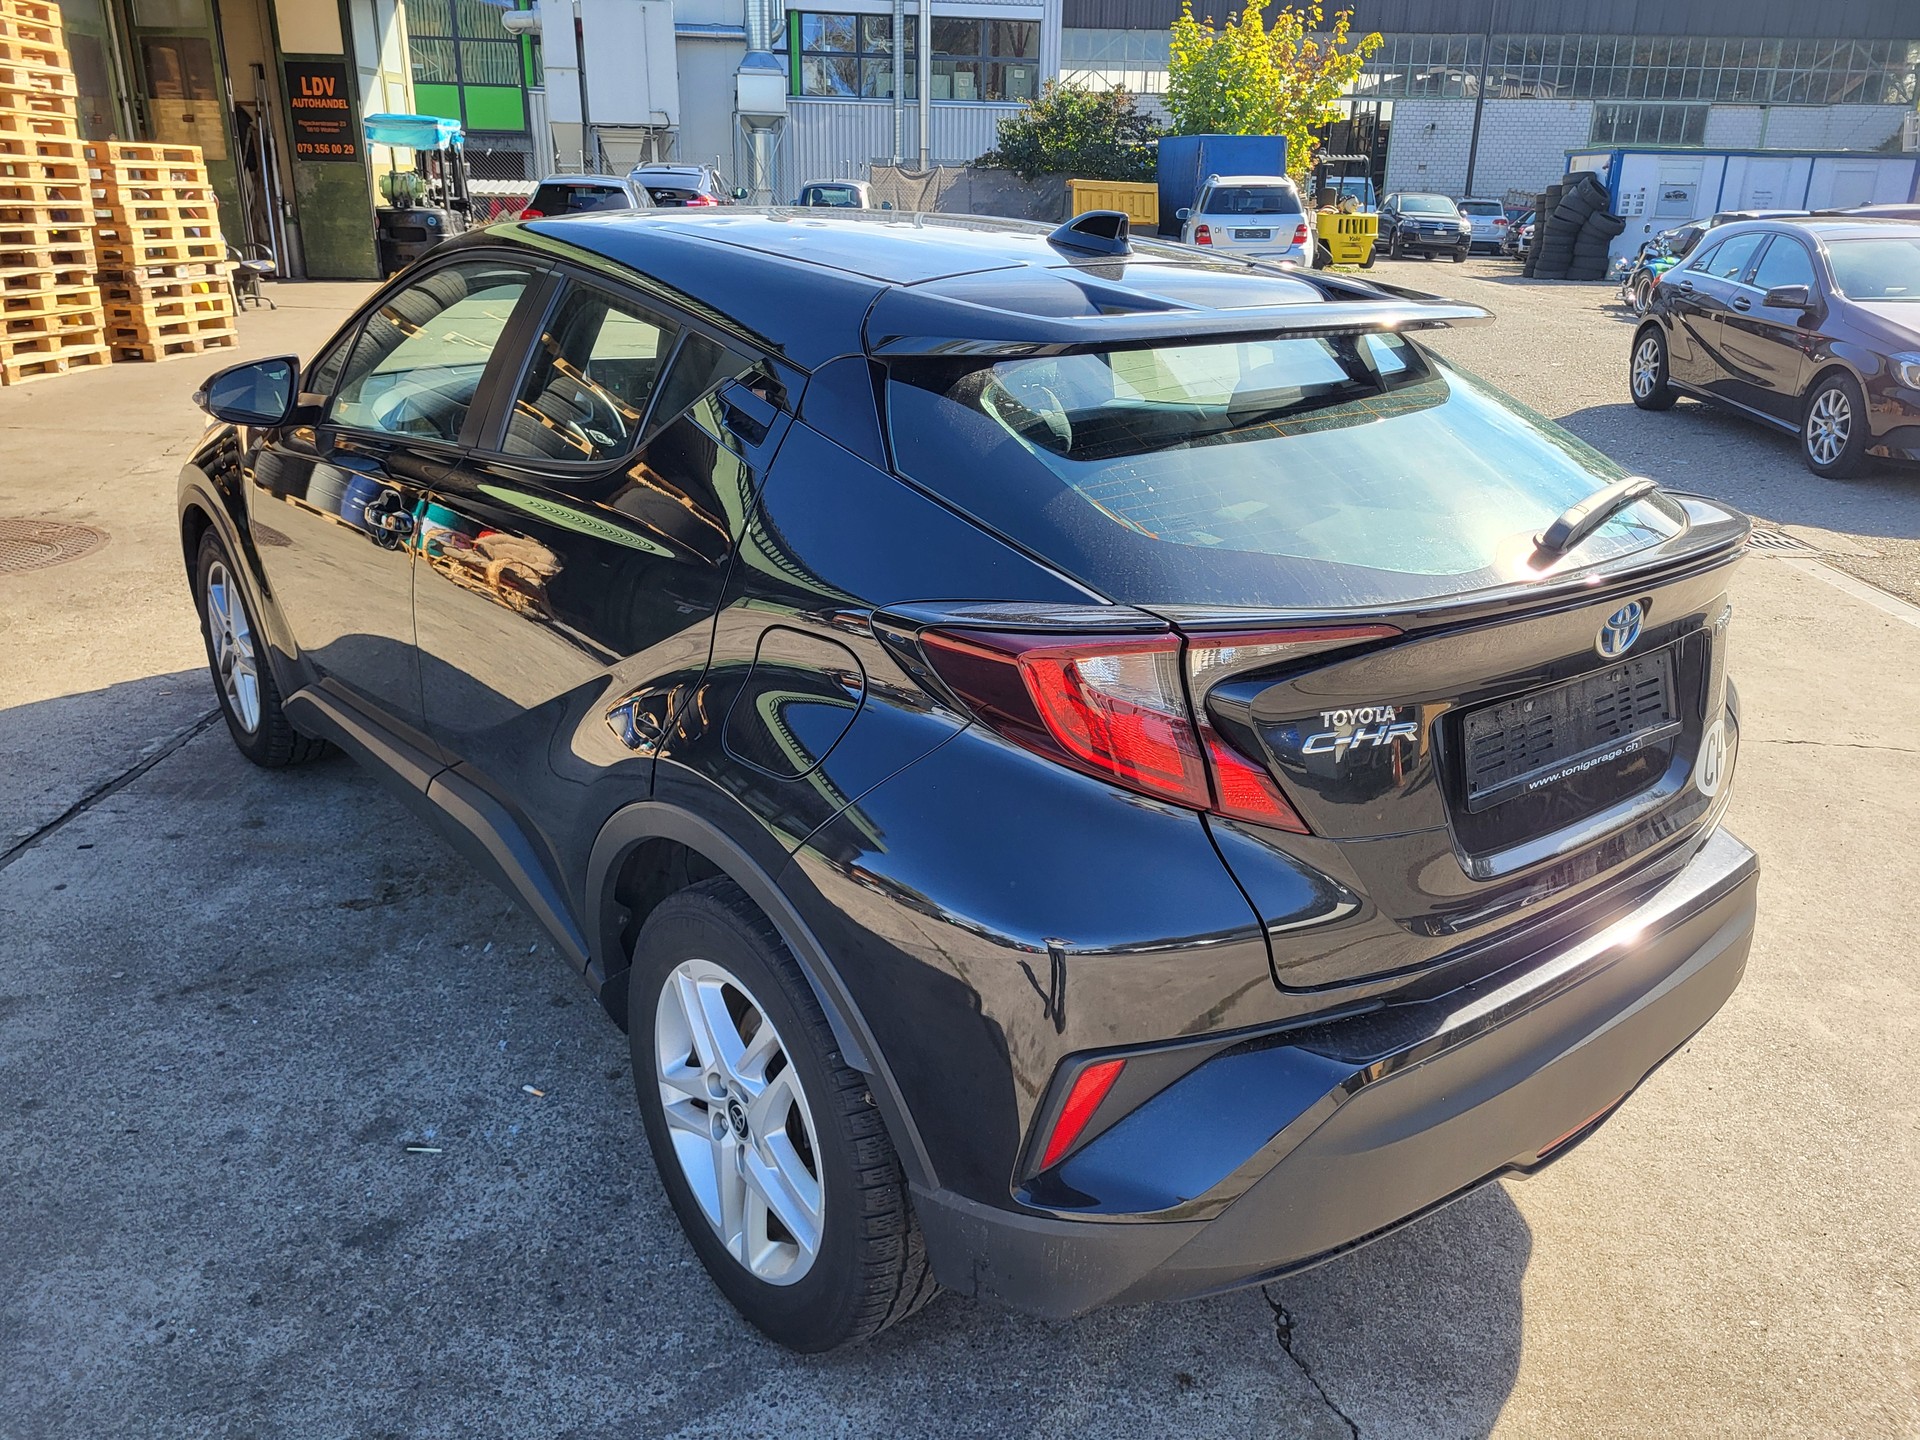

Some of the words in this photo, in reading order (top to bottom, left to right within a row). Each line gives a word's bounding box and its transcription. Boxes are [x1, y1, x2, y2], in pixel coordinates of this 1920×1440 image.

[301, 76, 335, 96] LDV
[292, 98, 349, 109] AUTOHANDEL
[297, 143, 312, 153] 079
[314, 144, 330, 154] 356
[331, 144, 342, 154] 00
[343, 144, 354, 154] 29
[1214, 226, 1222, 234] CH
[1320, 705, 1396, 728] TOYOTA
[1302, 722, 1418, 754] C-HR
[1528, 741, 1639, 790] www.tonigarage.ch
[1702, 728, 1722, 787] CH
